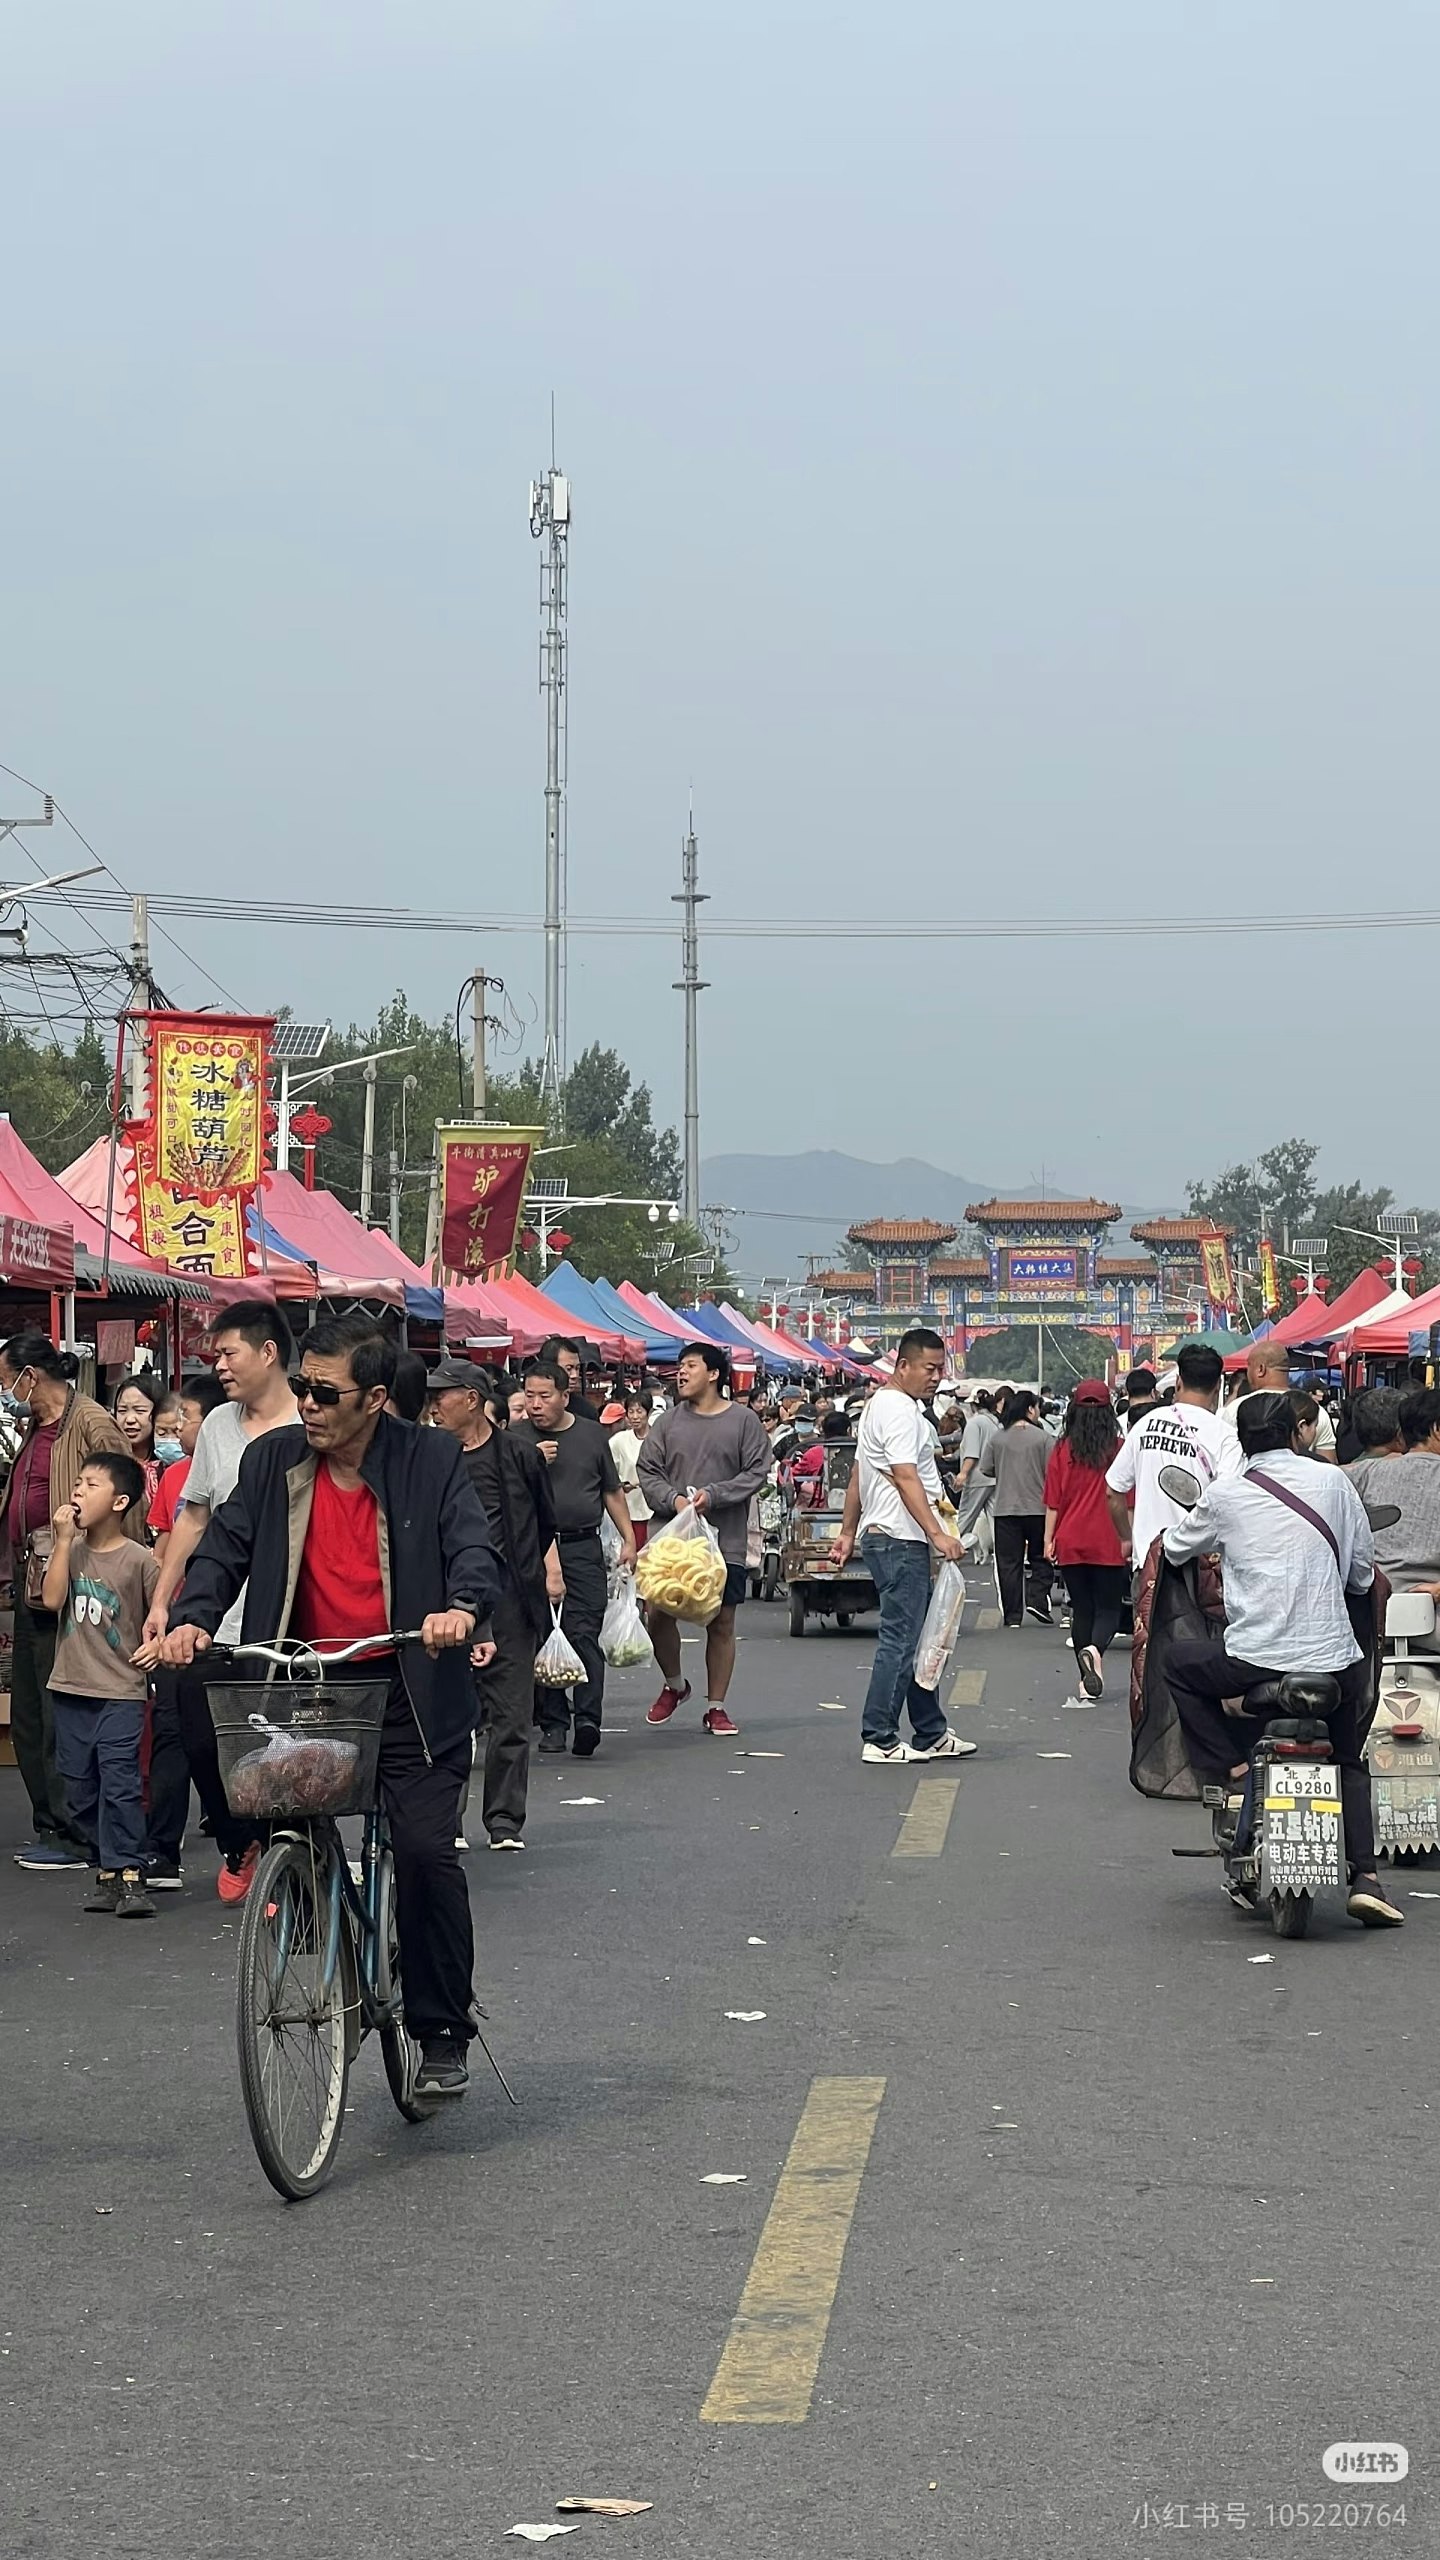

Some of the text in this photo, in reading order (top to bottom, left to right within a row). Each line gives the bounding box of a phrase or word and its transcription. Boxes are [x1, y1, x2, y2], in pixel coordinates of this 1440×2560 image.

[190, 1061, 231, 1166] 冰糖葫芦
[451, 1146, 525, 1161] 牛街清真小吃
[149, 1204, 167, 1246] 粗粮
[464, 1164, 500, 1268] 驴打滚
[220, 1195, 237, 1277] 健康食
[1139, 1435, 1197, 1458] NEPHEWS
[1286, 1769, 1321, 1780] 北京
[1275, 1781, 1332, 1795] CL9280
[1268, 1810, 1339, 1843] 五星钻豹
[1269, 1842, 1339, 1865] 电动车专卖
[1269, 1875, 1339, 1885] 13269579116
